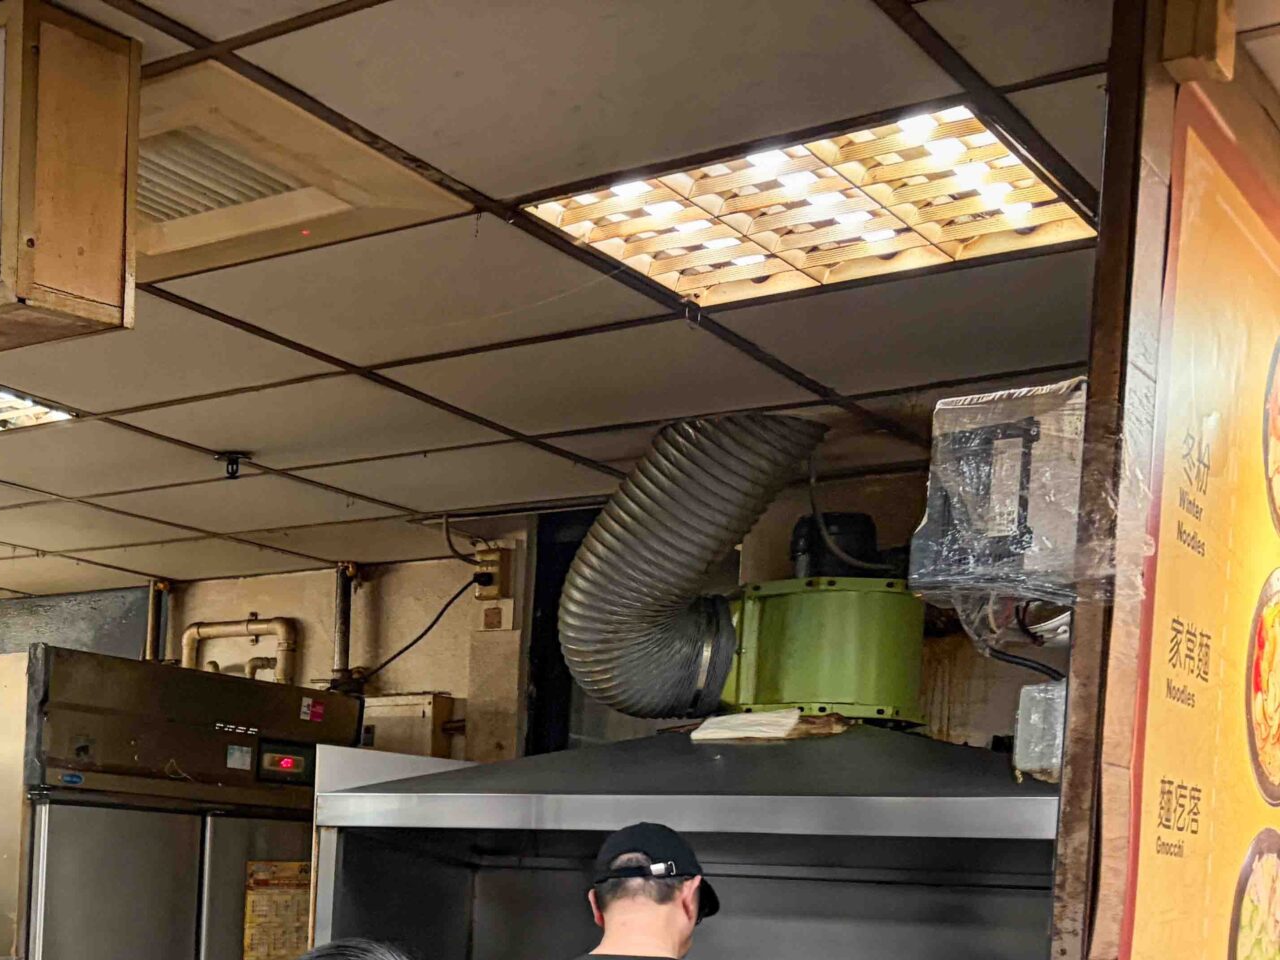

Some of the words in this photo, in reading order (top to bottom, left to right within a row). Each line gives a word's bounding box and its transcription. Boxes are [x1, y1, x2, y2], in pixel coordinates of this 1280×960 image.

[1182, 429, 1211, 496] 冬粉
[1178, 487, 1204, 522] Winter
[1176, 520, 1207, 557] Noodles
[1168, 615, 1212, 683] 家常麵
[1165, 678, 1196, 709] Noodles
[1155, 836, 1185, 858] Gnocchi
